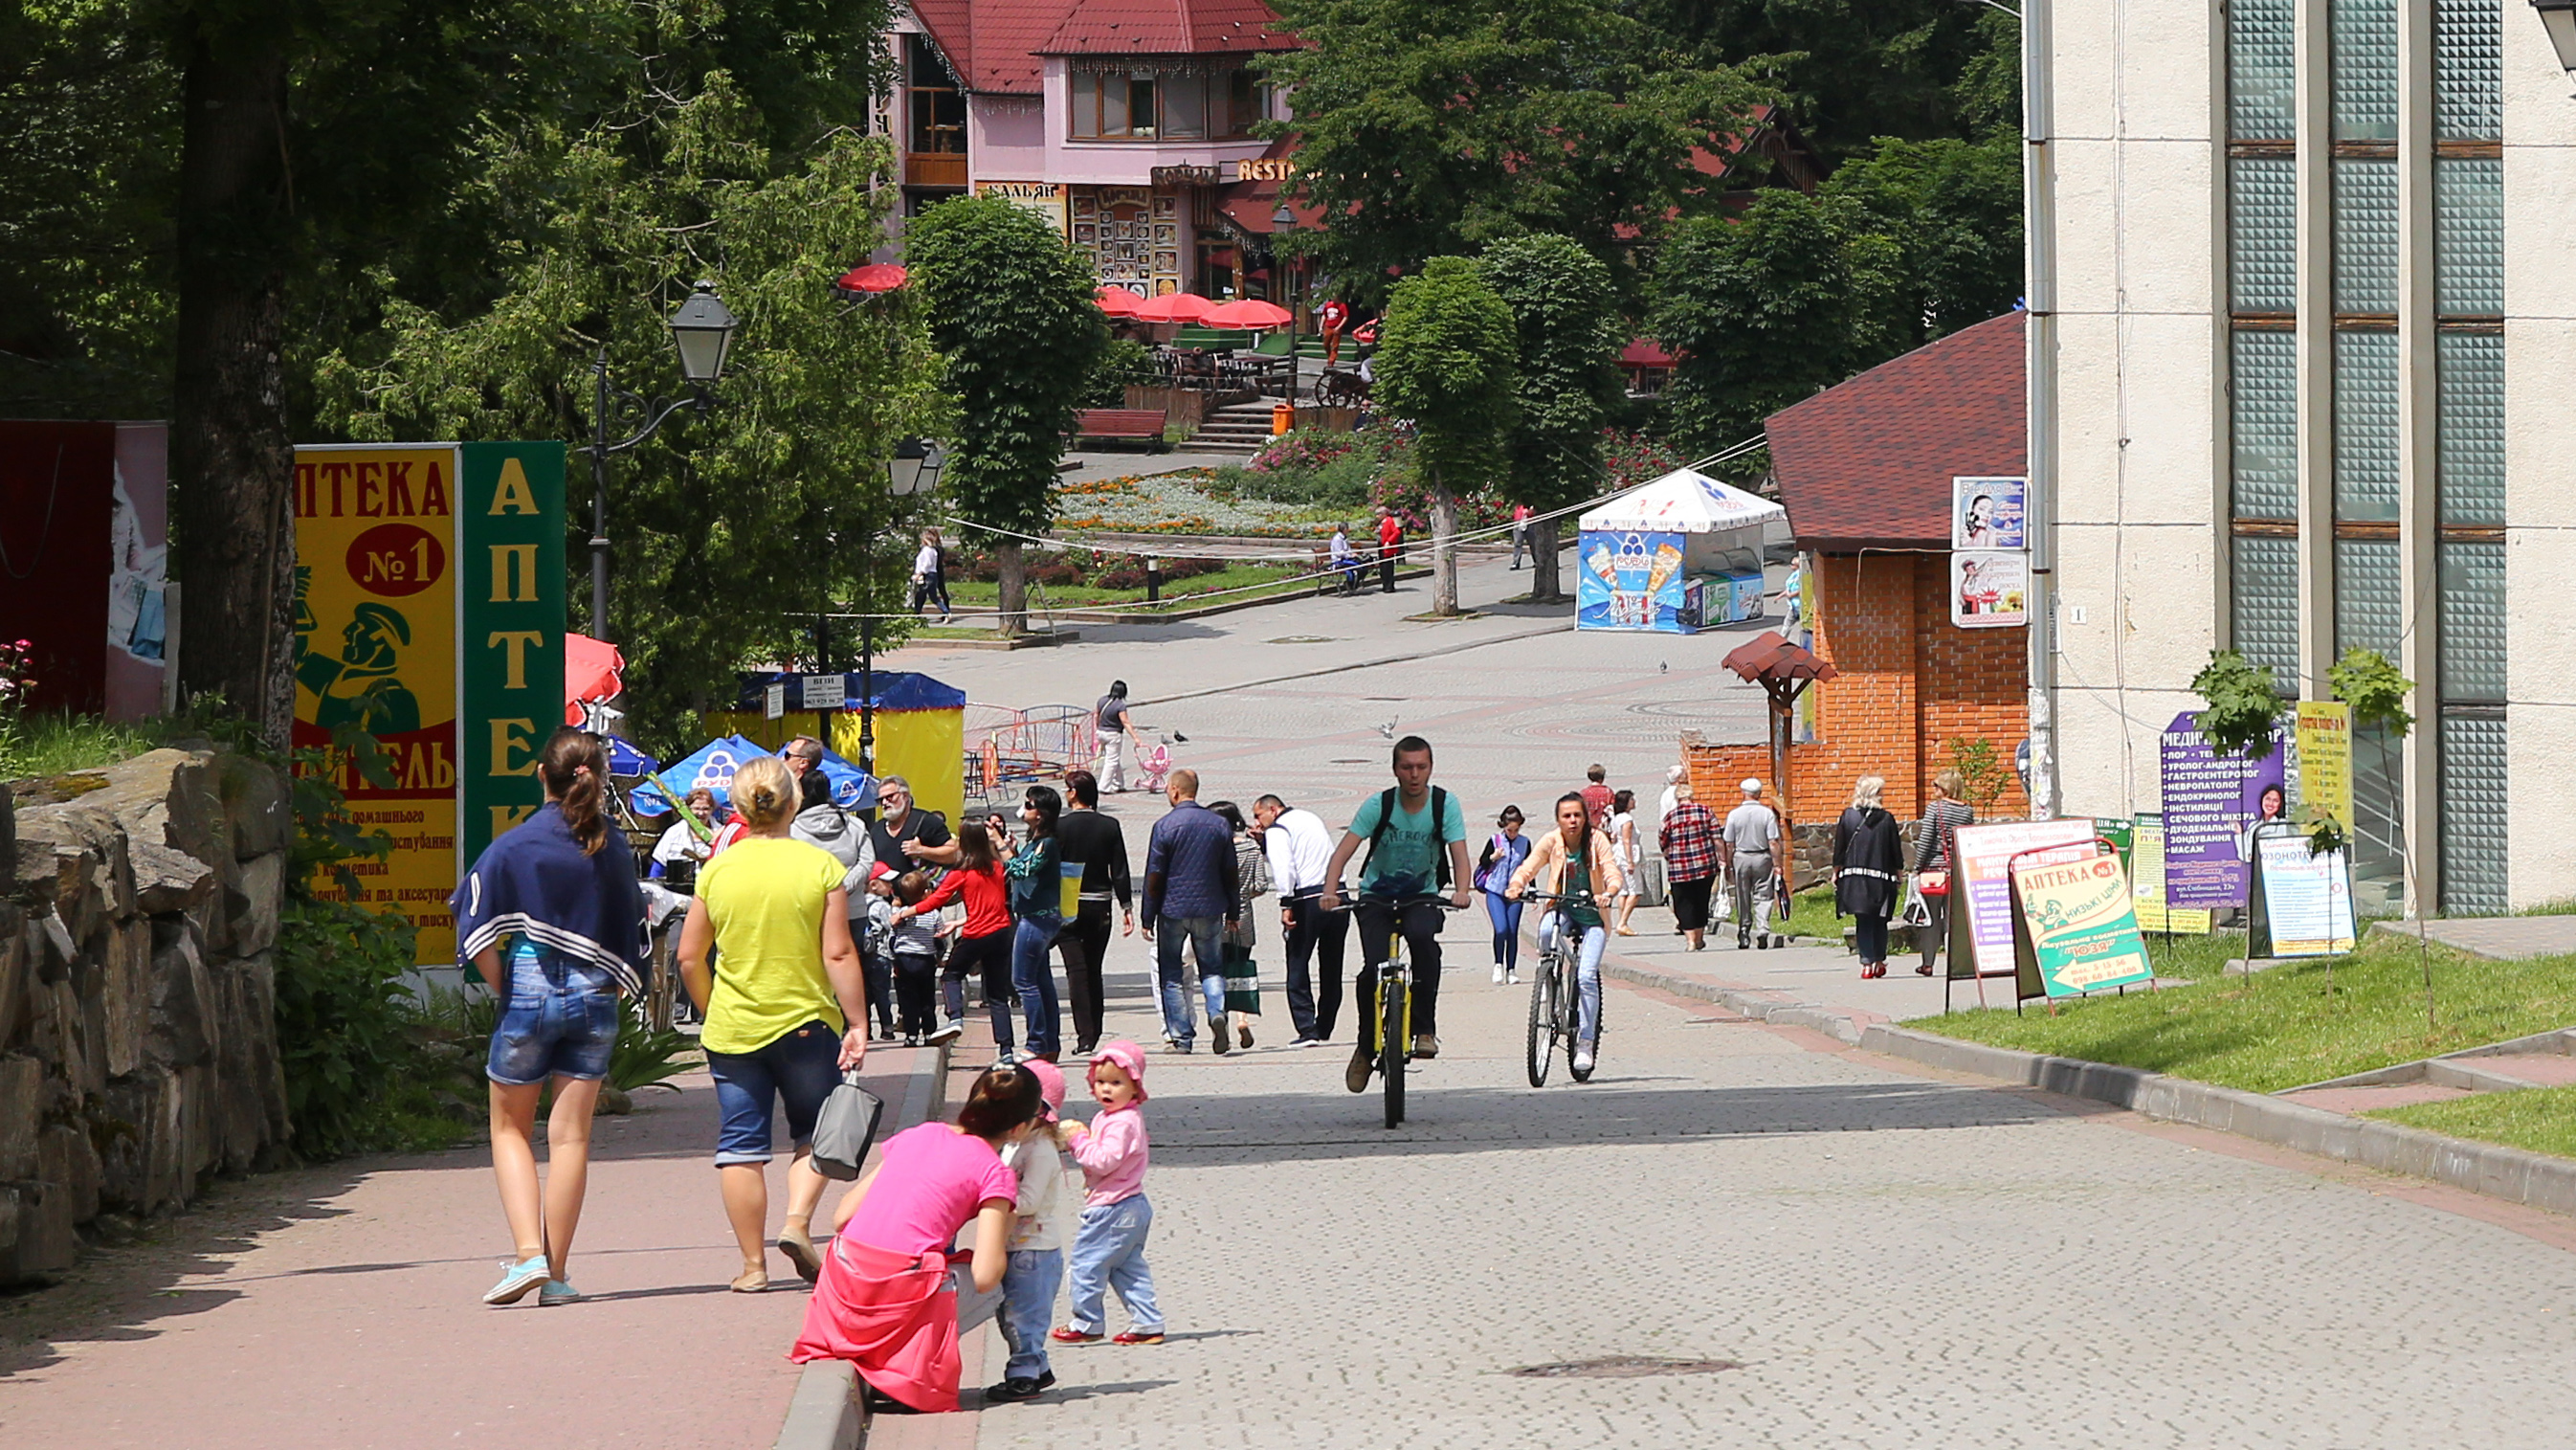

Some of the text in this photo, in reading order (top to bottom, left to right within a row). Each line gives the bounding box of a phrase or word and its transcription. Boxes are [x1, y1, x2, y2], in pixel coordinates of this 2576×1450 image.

[294, 461, 450, 518] ПТЕКА
[364, 537, 431, 583] №1
[487, 457, 542, 844] АПТЕК
[2163, 730, 2220, 747] МЕДИ
[2167, 750, 2187, 760] ЛОР
[696, 778, 732, 789] РУД
[2167, 791, 2241, 802] ЕНДОКРИНОЛОГ
[352, 810, 425, 825] домашнього
[2169, 812, 2256, 824] СЕЧОВОГО МІХРА
[391, 831, 454, 853] истування
[2169, 834, 2232, 844] ЗОНДУВАННЯ
[2170, 845, 2206, 855] МАСАЖ
[2024, 866, 2091, 891] АПТЕКА
[2096, 861, 2115, 876] №1
[376, 888, 394, 902] та
[2065, 878, 2122, 920] НИЗЬКІ ЦІНИ
[419, 914, 455, 930] тиску
